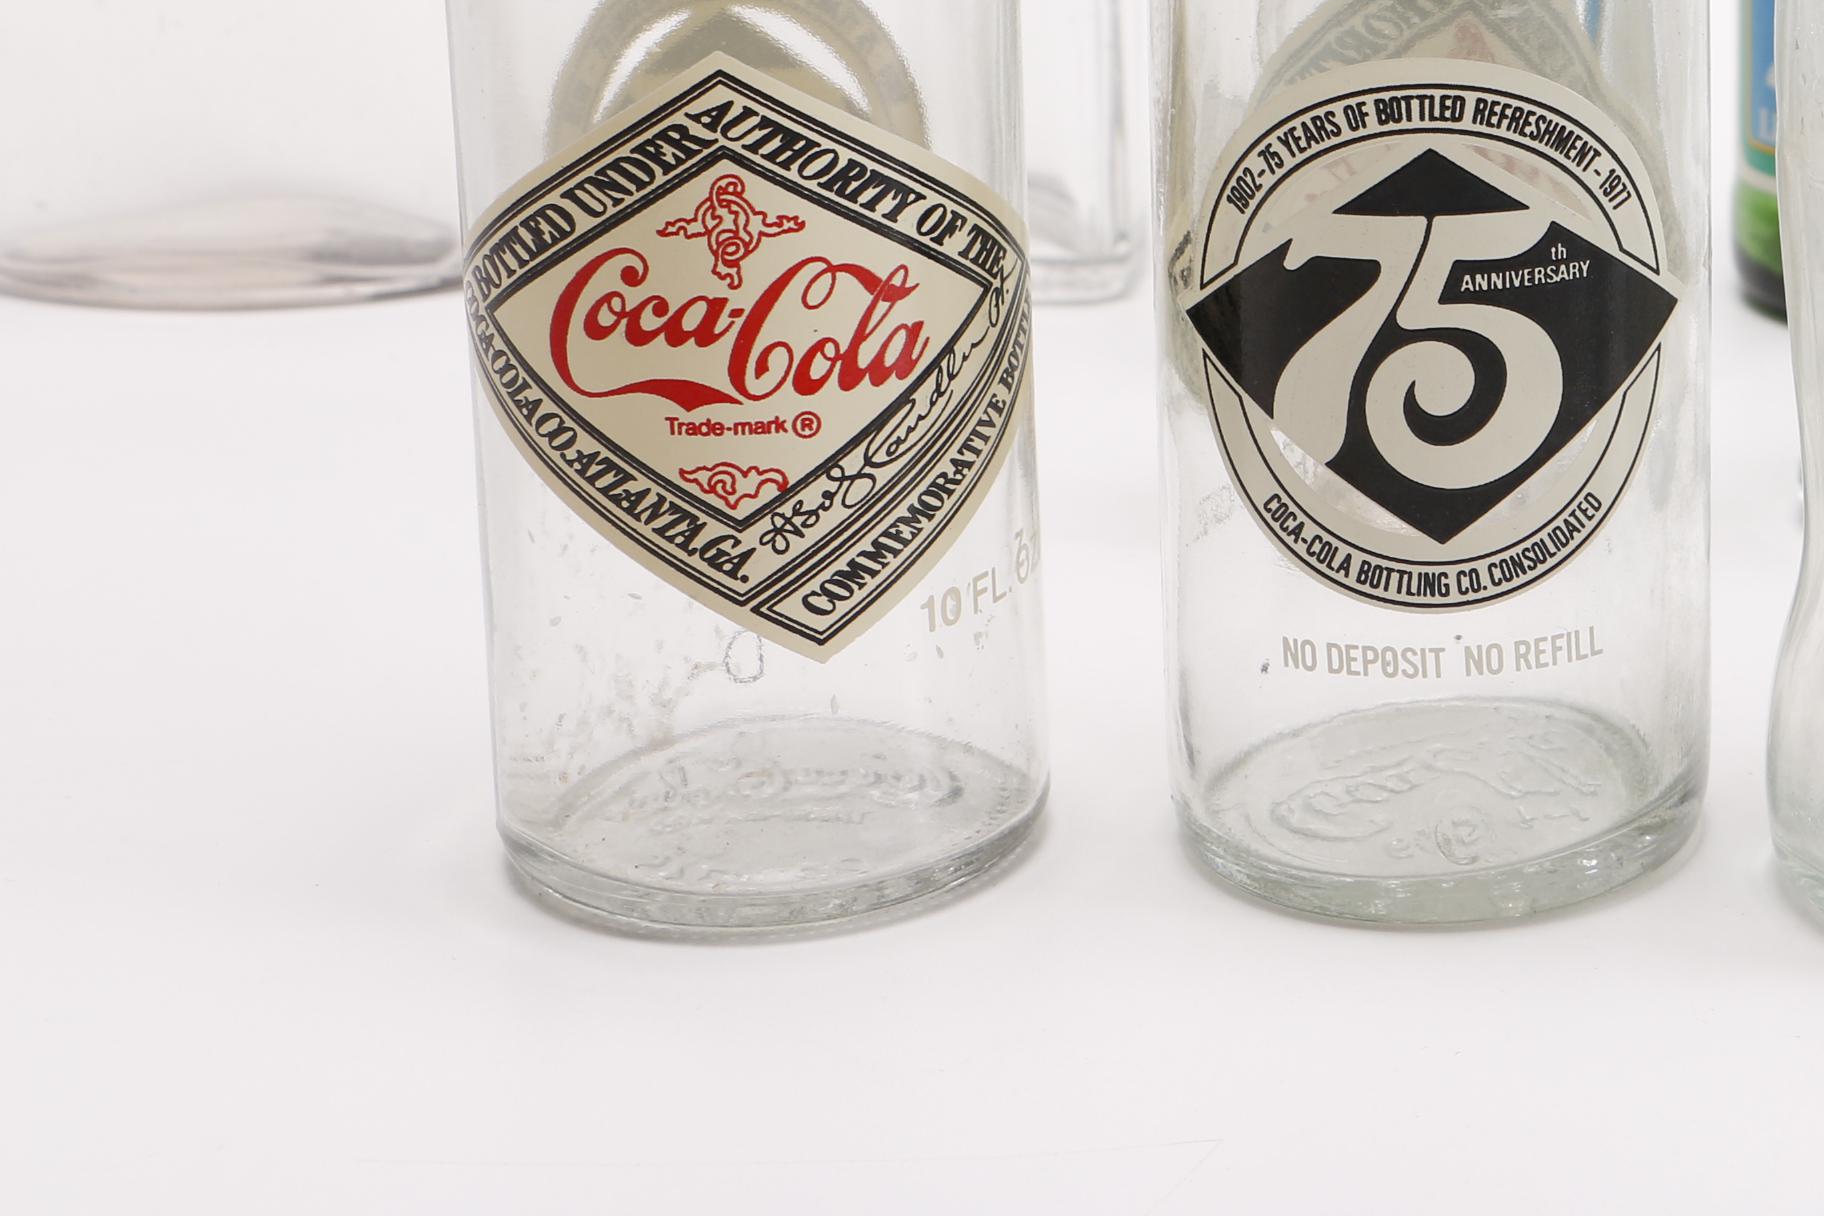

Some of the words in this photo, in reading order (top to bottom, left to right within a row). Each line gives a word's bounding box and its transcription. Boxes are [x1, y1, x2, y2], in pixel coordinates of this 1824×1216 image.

[1277, 110, 1342, 158] YEARS
[1343, 101, 1369, 132] OF
[1374, 94, 1466, 126] BOTTLED
[472, 203, 577, 302] BOTTLED
[565, 121, 721, 216] UNDER
[686, 101, 922, 224] AUTHORITY
[916, 203, 967, 246] OF
[958, 223, 1008, 280] THE
[1460, 259, 1591, 293] ANNIVERSARY
[1551, 243, 1567, 262] th
[549, 247, 931, 413] Coca-Cola
[1273, 212, 1563, 489] 75
[665, 416, 788, 437] Trade-mark
[800, 393, 1006, 618] COMMEMORATIVE
[699, 534, 757, 583] GA.
[1263, 493, 1353, 578] COCA-COLA
[1355, 561, 1450, 598] BOTTLING
[1456, 568, 1488, 596] CO.
[1489, 491, 1603, 587] CONSOLIDATED
[920, 586, 962, 632] 10
[1282, 636, 1318, 672] NO
[1326, 642, 1446, 679] DEPOSIT
[1464, 642, 1504, 677] NO
[1514, 626, 1604, 672] REFILL
